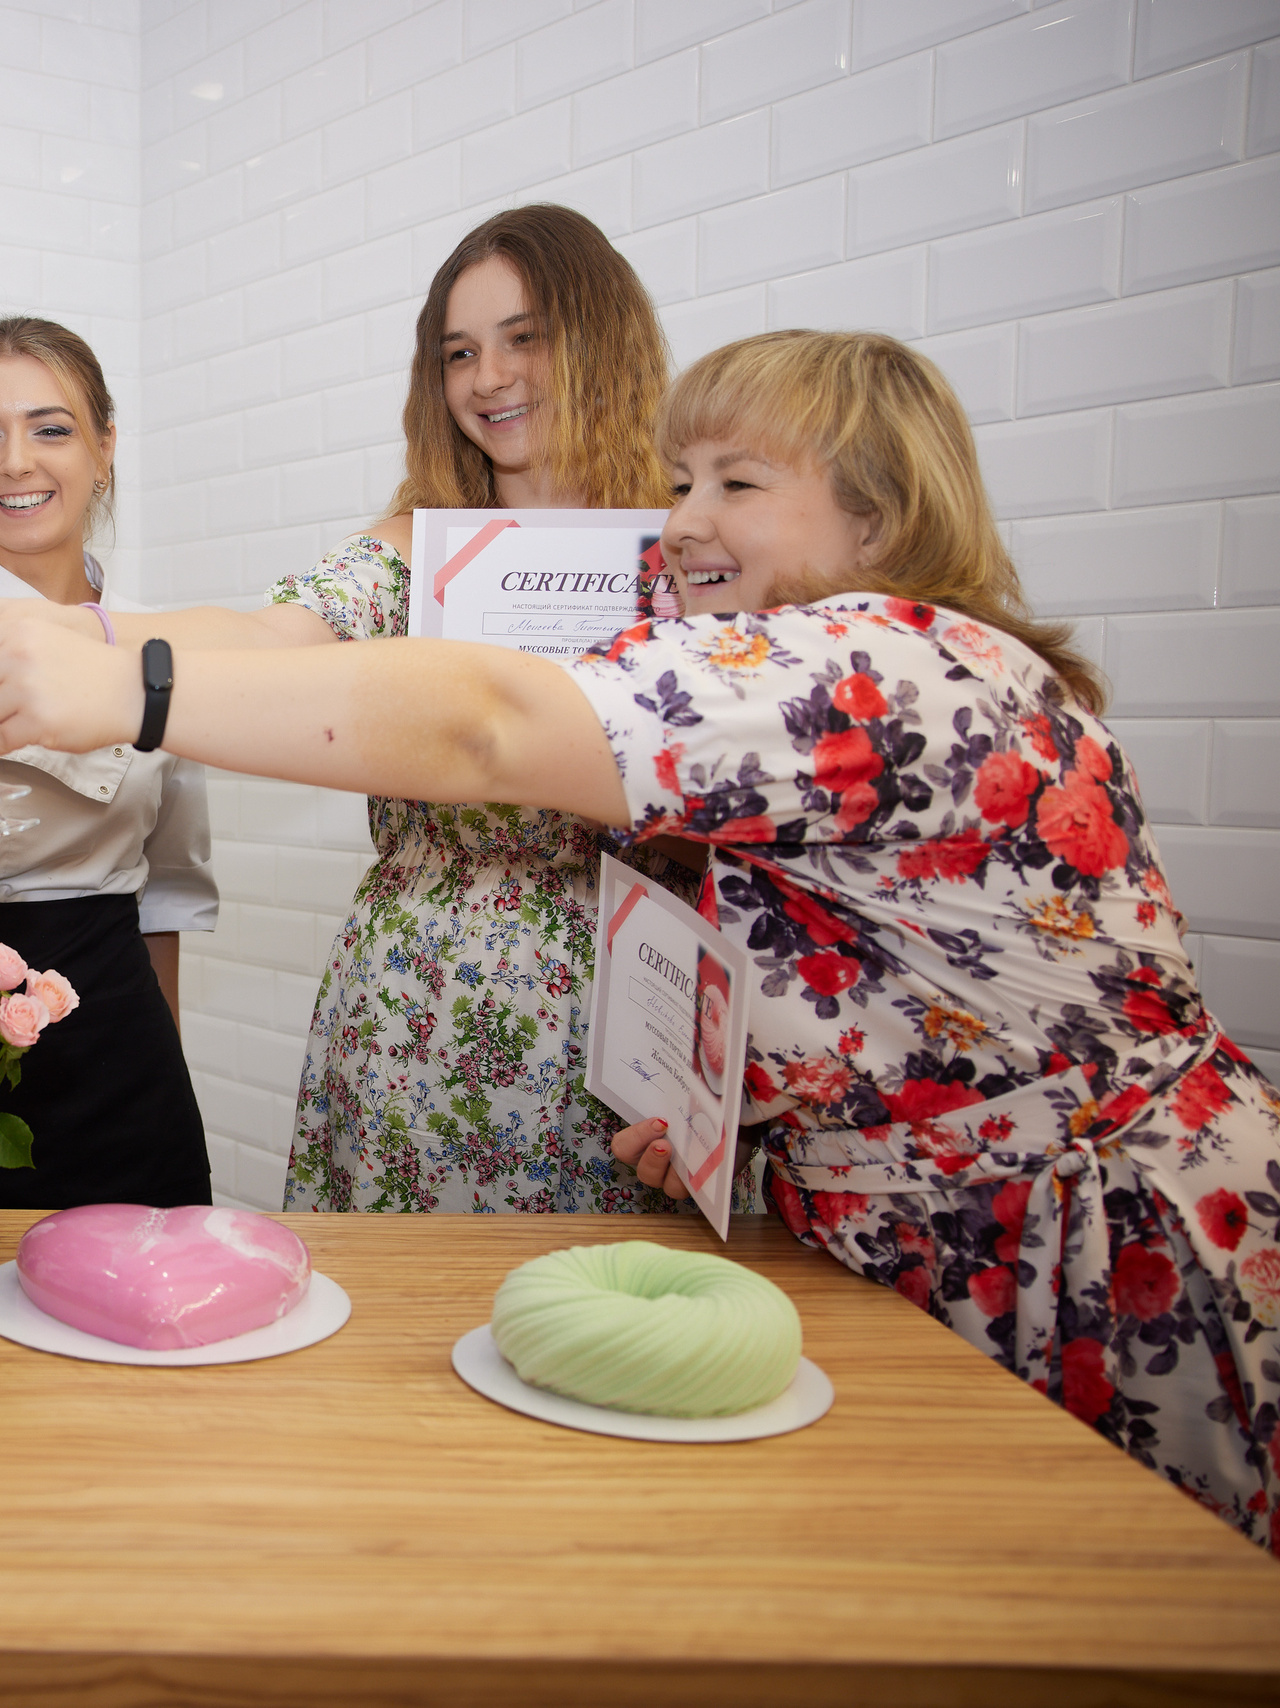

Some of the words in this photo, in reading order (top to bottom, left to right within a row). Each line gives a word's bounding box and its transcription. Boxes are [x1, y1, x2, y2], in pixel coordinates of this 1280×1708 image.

[500, 571, 679, 594] CERTIFICATE
[512, 603, 552, 611] НАСТОЯЩИЙ
[518, 645, 570, 655] МУССОВЫЕ
[638, 942, 714, 1020] CERTIFICATE
